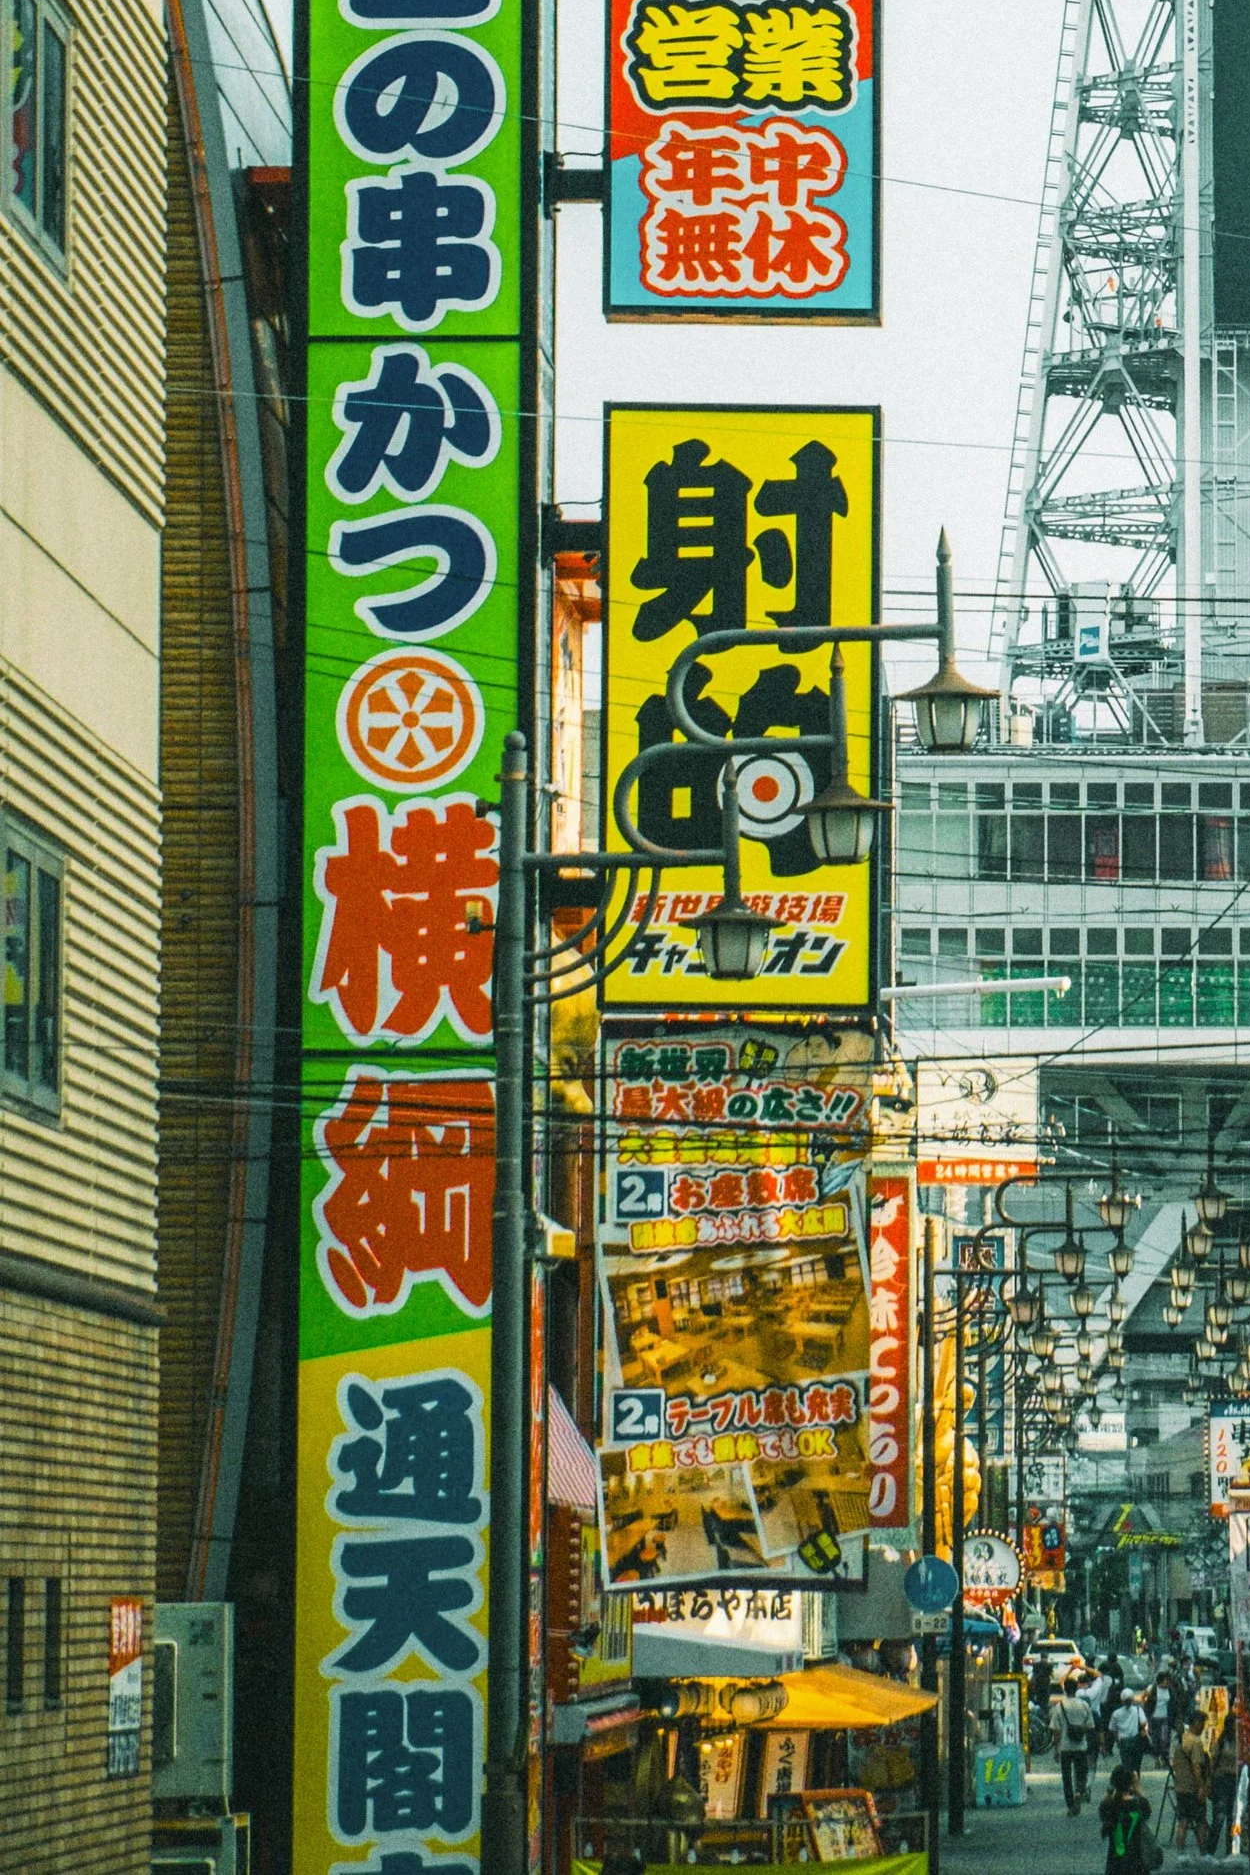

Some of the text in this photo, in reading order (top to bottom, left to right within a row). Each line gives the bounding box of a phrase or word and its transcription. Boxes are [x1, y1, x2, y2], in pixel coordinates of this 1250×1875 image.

[635, 1, 846, 103] 営業
[655, 128, 832, 208] 年中
[654, 211, 834, 282] 無休
[630, 438, 849, 877] 射的
[628, 930, 845, 975] チャオン
[318, 803, 499, 1308] 横綱
[331, 1377, 479, 1875] 通天閣
